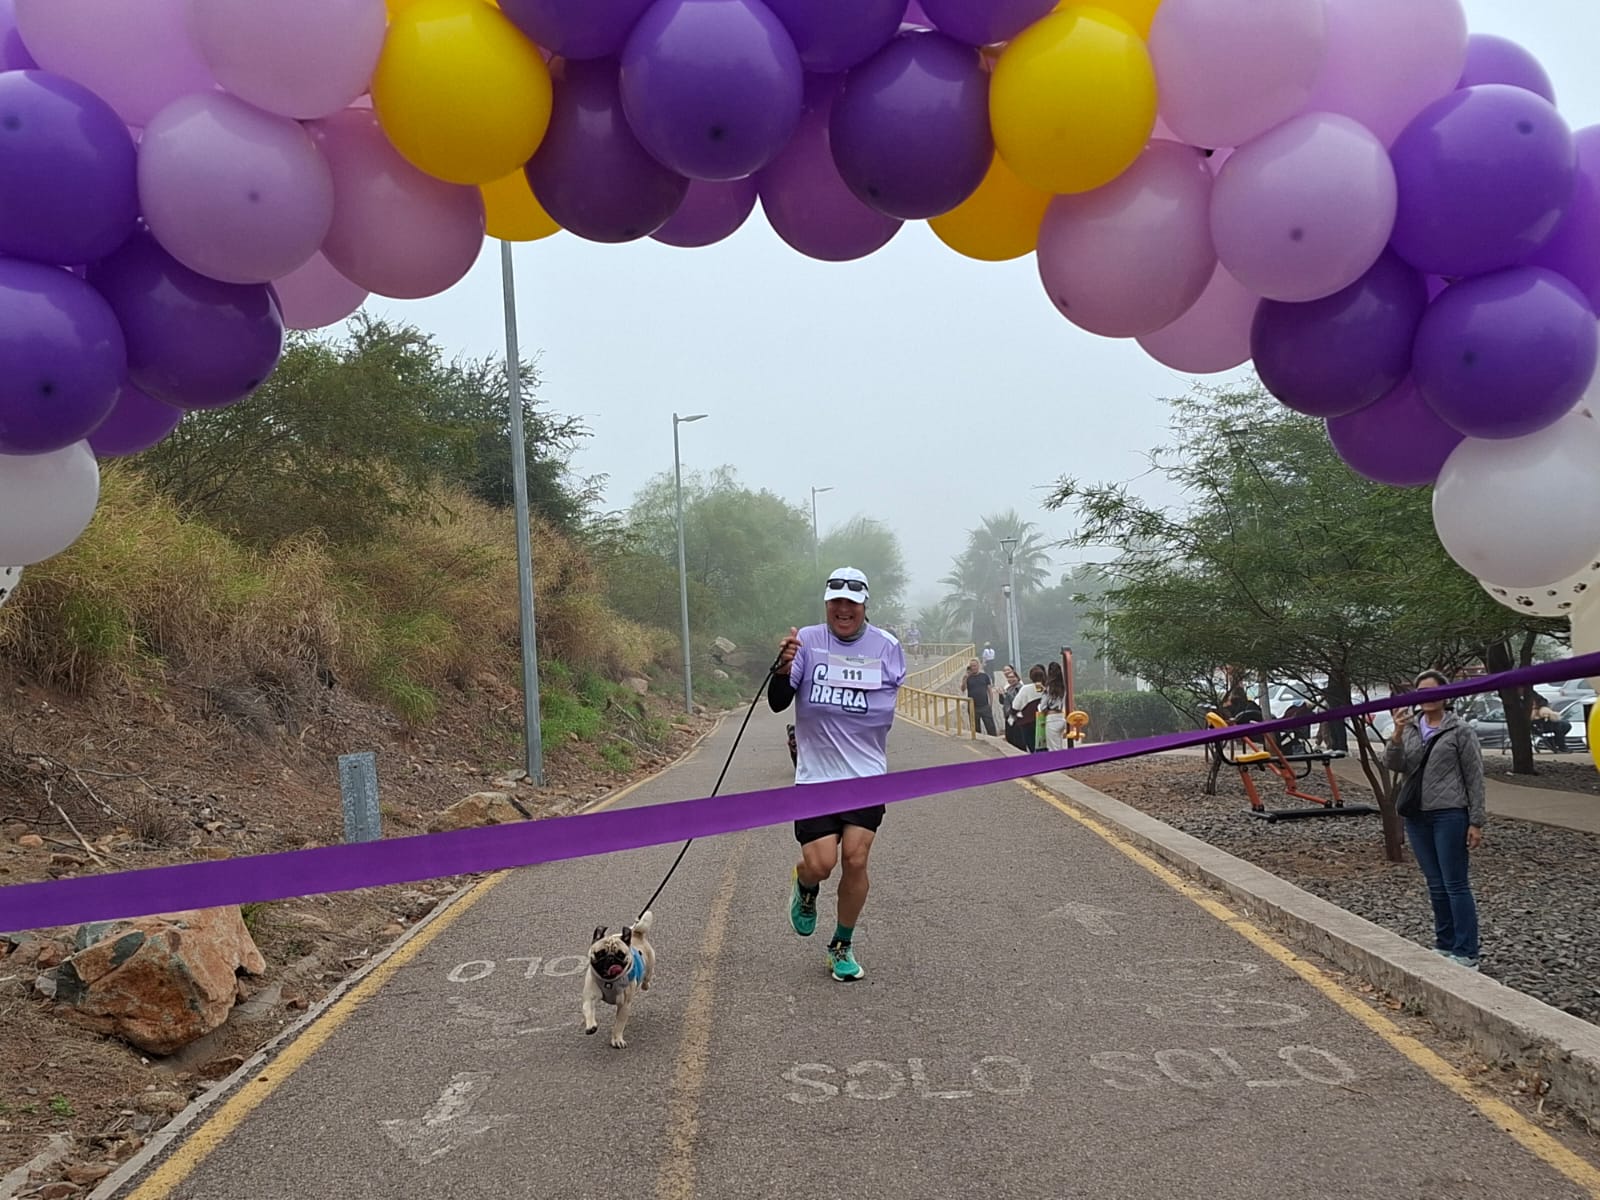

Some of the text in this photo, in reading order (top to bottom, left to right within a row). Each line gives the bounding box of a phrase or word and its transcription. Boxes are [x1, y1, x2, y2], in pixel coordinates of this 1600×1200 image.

[841, 669, 863, 681] 111
[811, 686, 867, 707] RRERA
[447, 955, 590, 982] OLO
[783, 1054, 1032, 1102] SOLO
[1090, 1045, 1356, 1091] SOLO
